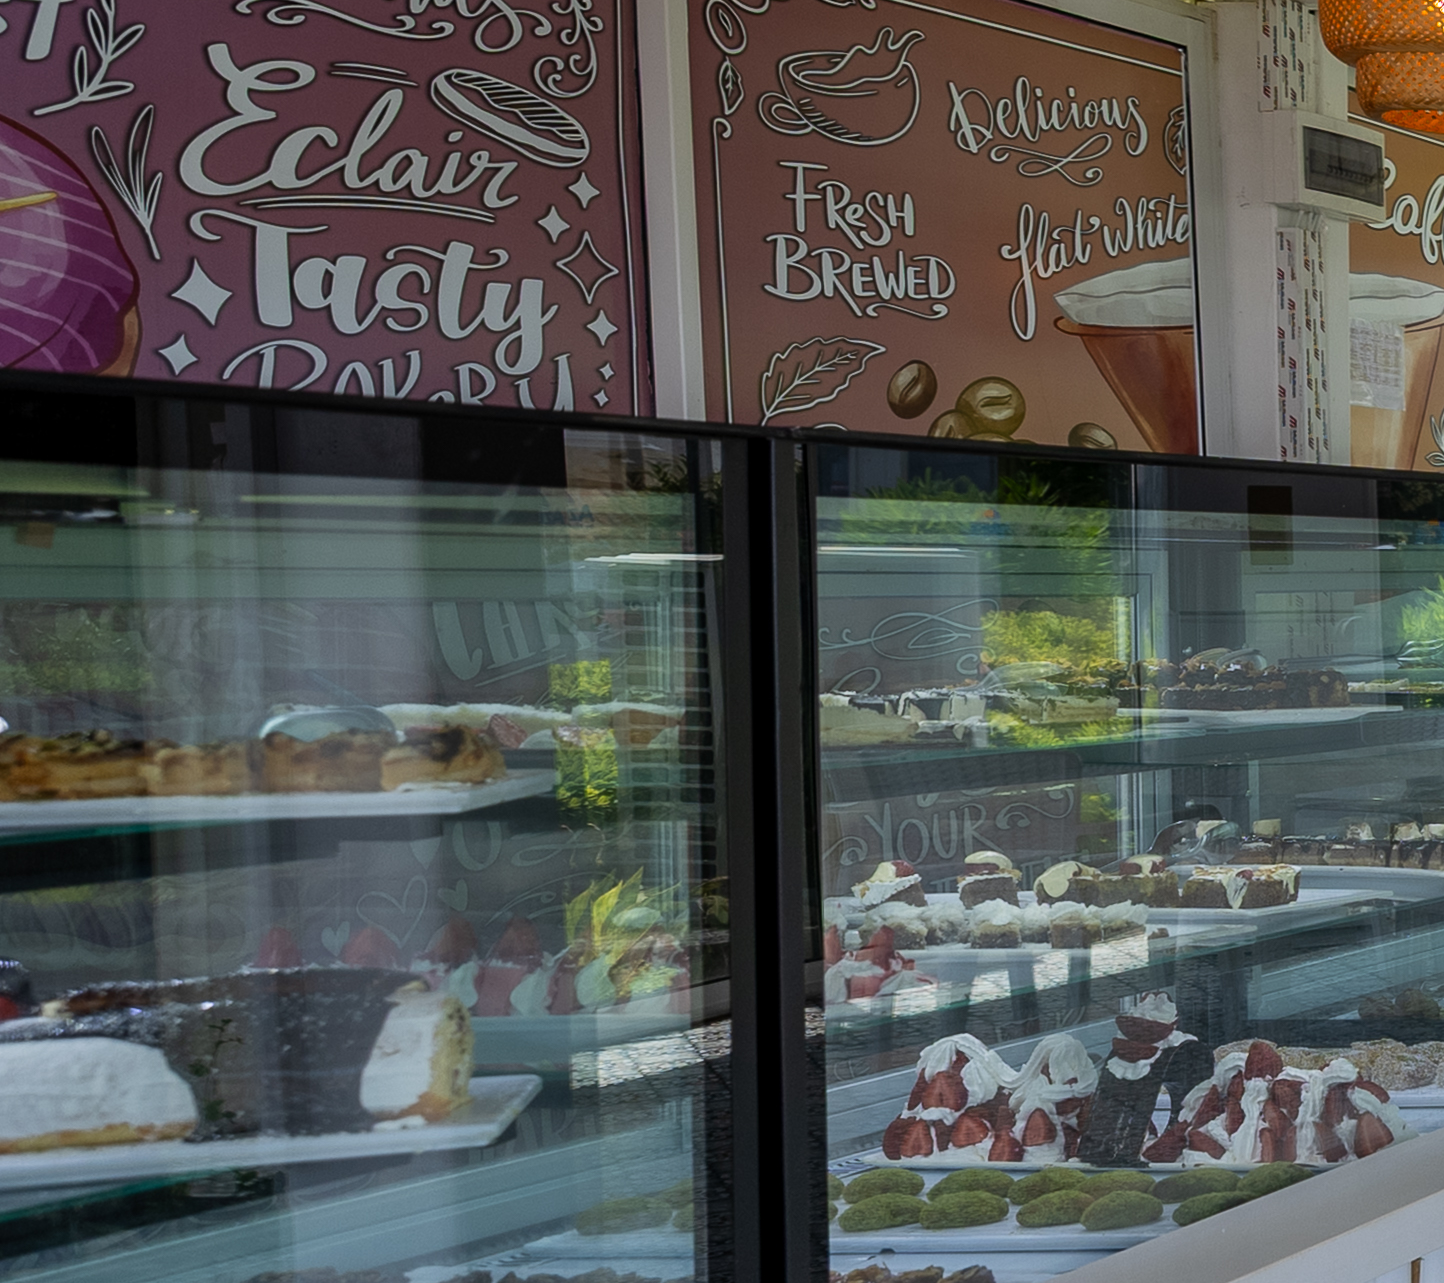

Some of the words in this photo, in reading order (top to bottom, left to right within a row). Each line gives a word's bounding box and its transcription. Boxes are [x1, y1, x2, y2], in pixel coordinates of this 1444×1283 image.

[179, 43, 519, 208] Eclair
[948, 77, 1149, 156] Delicious
[189, 209, 559, 375] Tasty
[763, 234, 956, 317] BREWED
